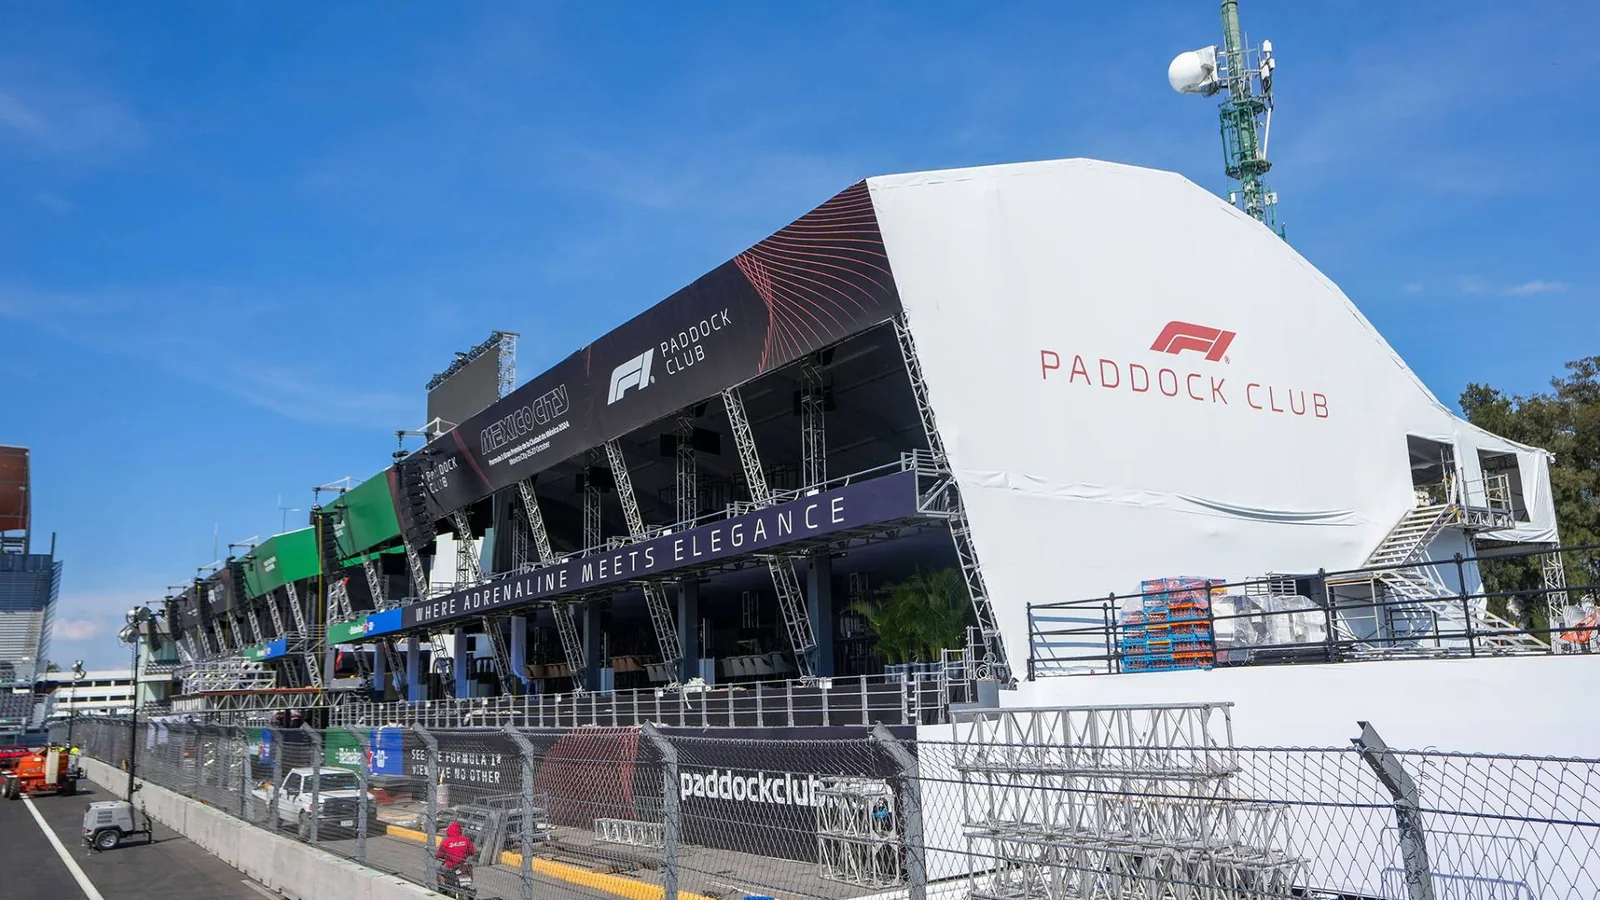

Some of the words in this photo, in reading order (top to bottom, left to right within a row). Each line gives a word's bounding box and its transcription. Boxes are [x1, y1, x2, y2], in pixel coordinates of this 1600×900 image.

[660, 308, 732, 357] PADDOCK
[665, 344, 705, 375] CLUB
[1040, 349, 1228, 405] PADDOCK
[1246, 383, 1329, 418] CLUB
[480, 405, 535, 456] MEXICO
[415, 598, 456, 622] WHERE
[463, 569, 568, 611] ADRENALINE
[581, 547, 655, 583] MEETS
[674, 496, 845, 561] ELEGANCE
[470, 769, 500, 784] OTHER
